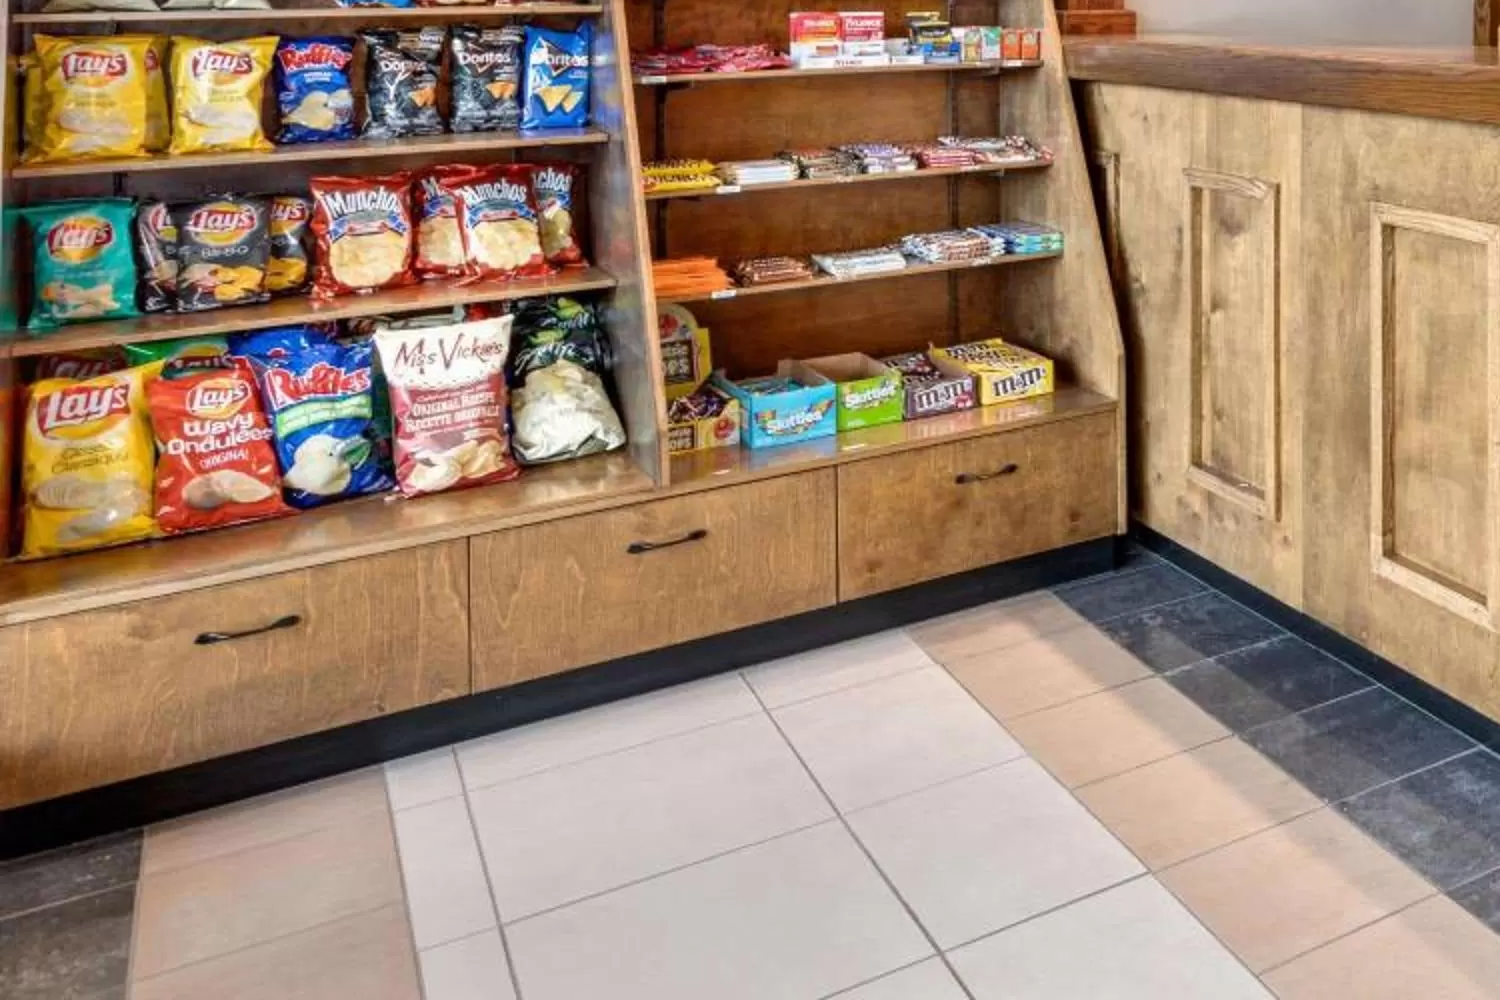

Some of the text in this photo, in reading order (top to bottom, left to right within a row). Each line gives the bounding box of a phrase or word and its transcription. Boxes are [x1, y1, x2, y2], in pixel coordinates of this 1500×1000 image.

[45, 383, 128, 429] Lay's
[193, 384, 250, 411] Lay's
[265, 363, 371, 410] Ruffles
